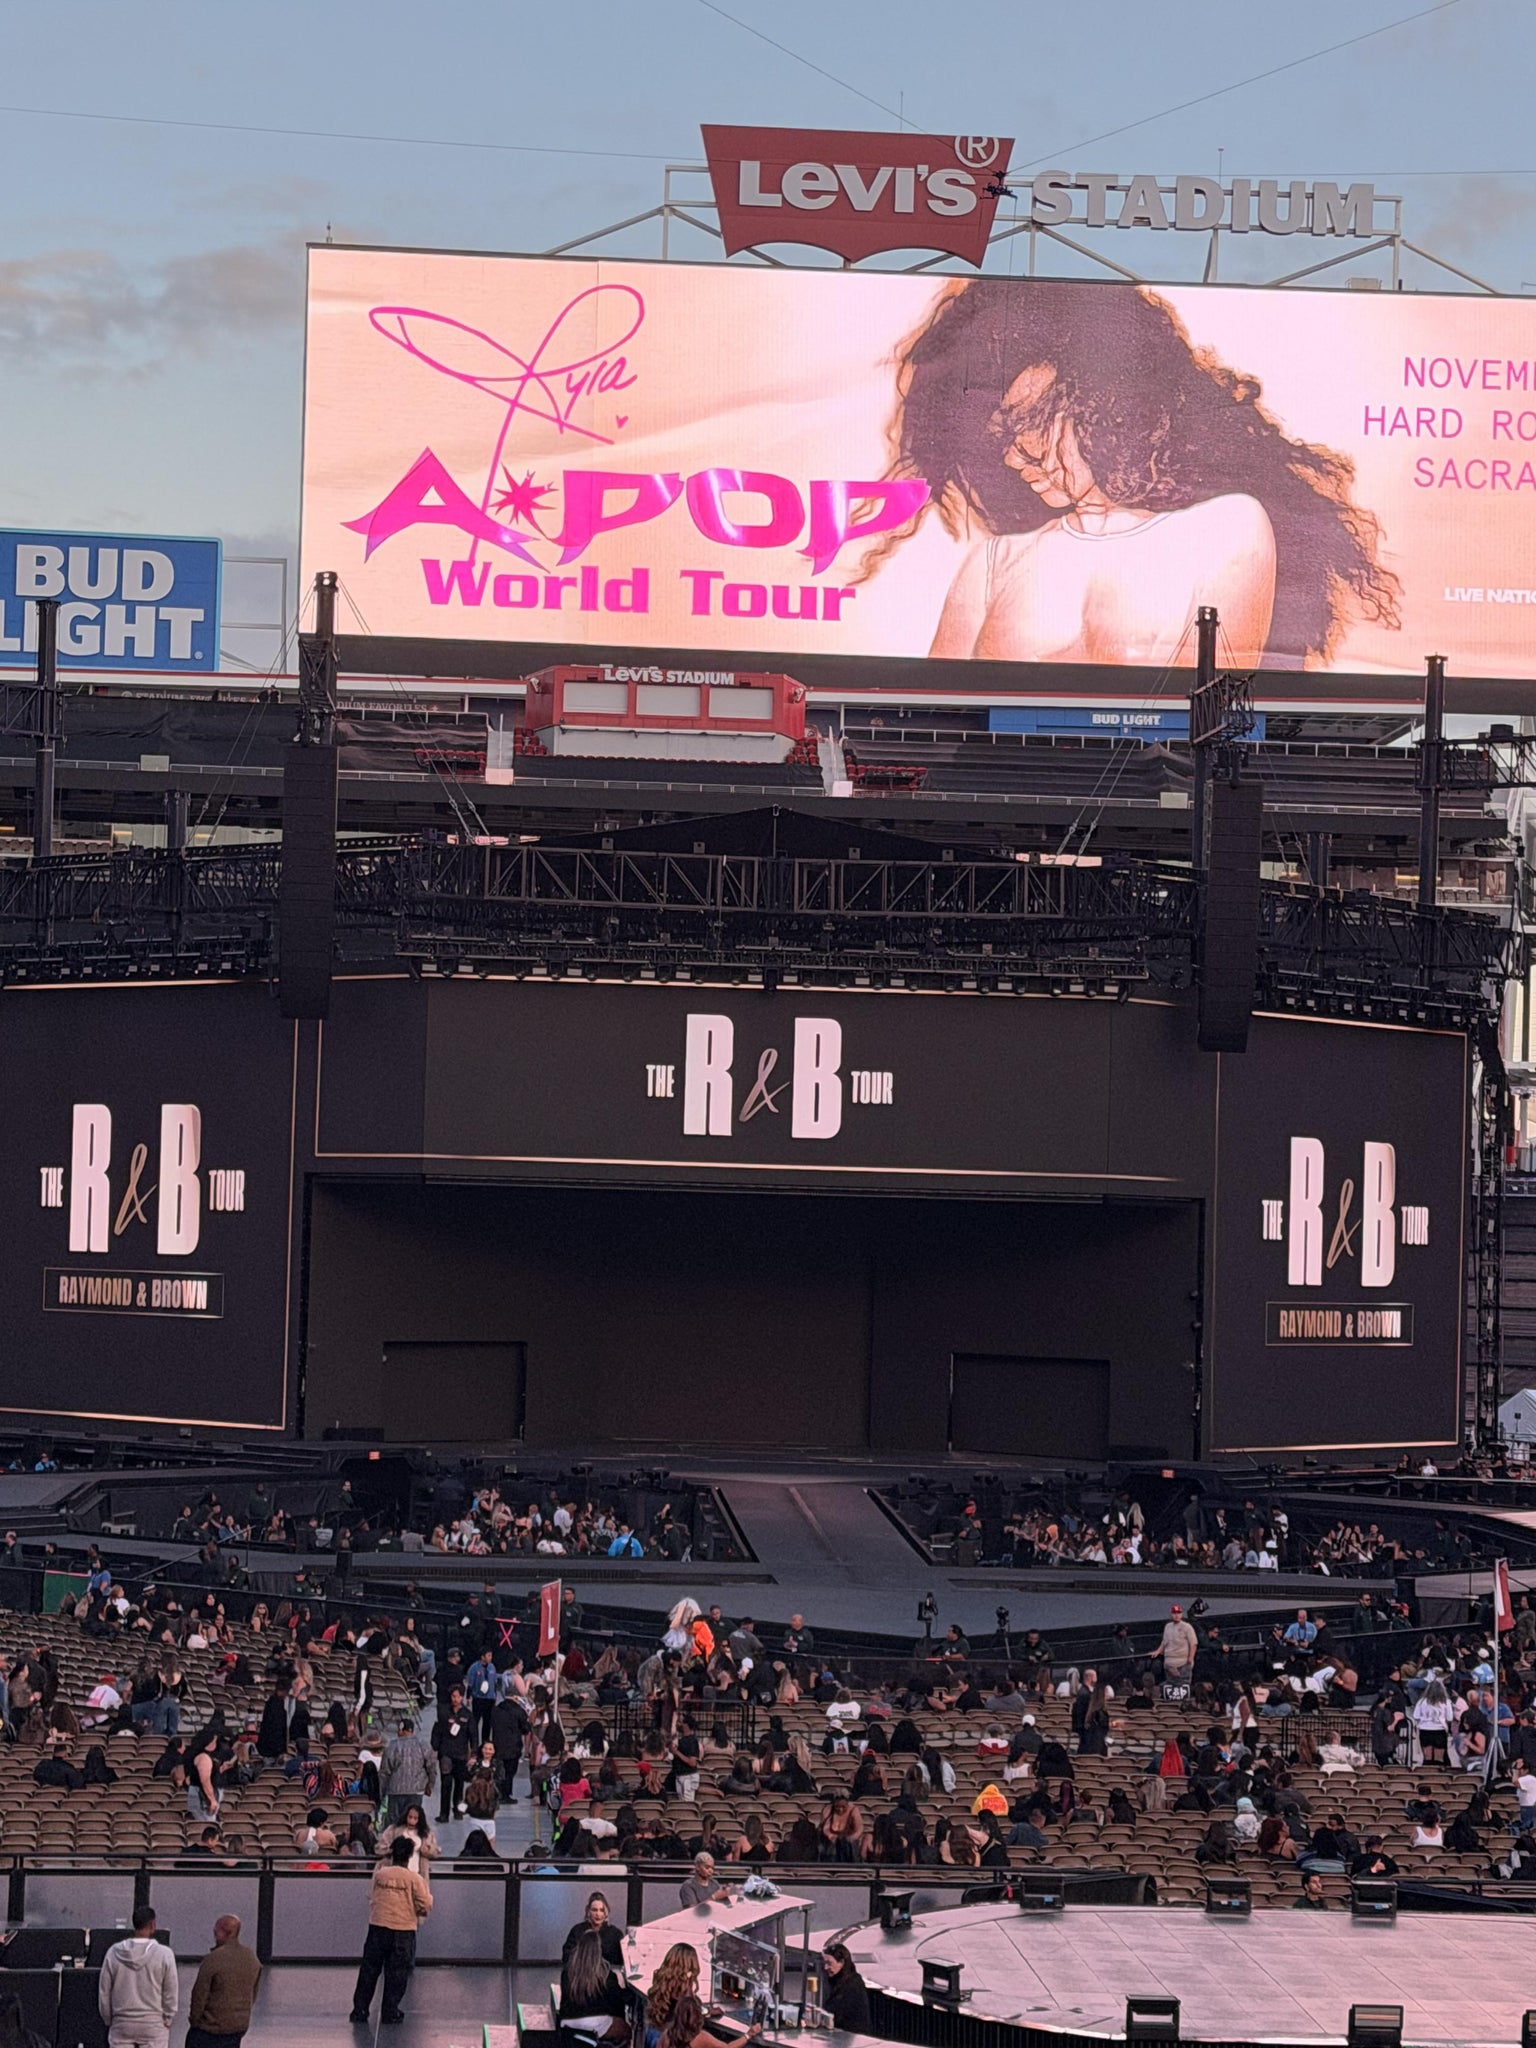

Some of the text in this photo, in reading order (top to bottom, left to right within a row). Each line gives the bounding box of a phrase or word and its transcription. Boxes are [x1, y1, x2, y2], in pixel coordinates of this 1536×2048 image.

[1031, 170, 1374, 238] STADIUM
[1403, 356, 1536, 391] NOVEM
[1363, 404, 1536, 442] HARD RO
[1413, 456, 1536, 491] SACRA
[15, 544, 175, 602] BUD
[420, 557, 857, 622] World Tour
[1444, 587, 1484, 602] LIVE
[666, 671, 735, 685] STADIUM
[1092, 713, 1161, 726] BUD LIGHT
[646, 1064, 675, 1097] THE
[851, 1071, 893, 1104] TOUR
[40, 1167, 64, 1207] THE
[208, 1170, 245, 1211] TOUR
[1262, 1200, 1283, 1240] THE
[1401, 1206, 1429, 1245] TOUR
[59, 1276, 208, 1309] RAYMOND & BROWN
[1279, 1310, 1401, 1338] RAYMOND & BROWN
